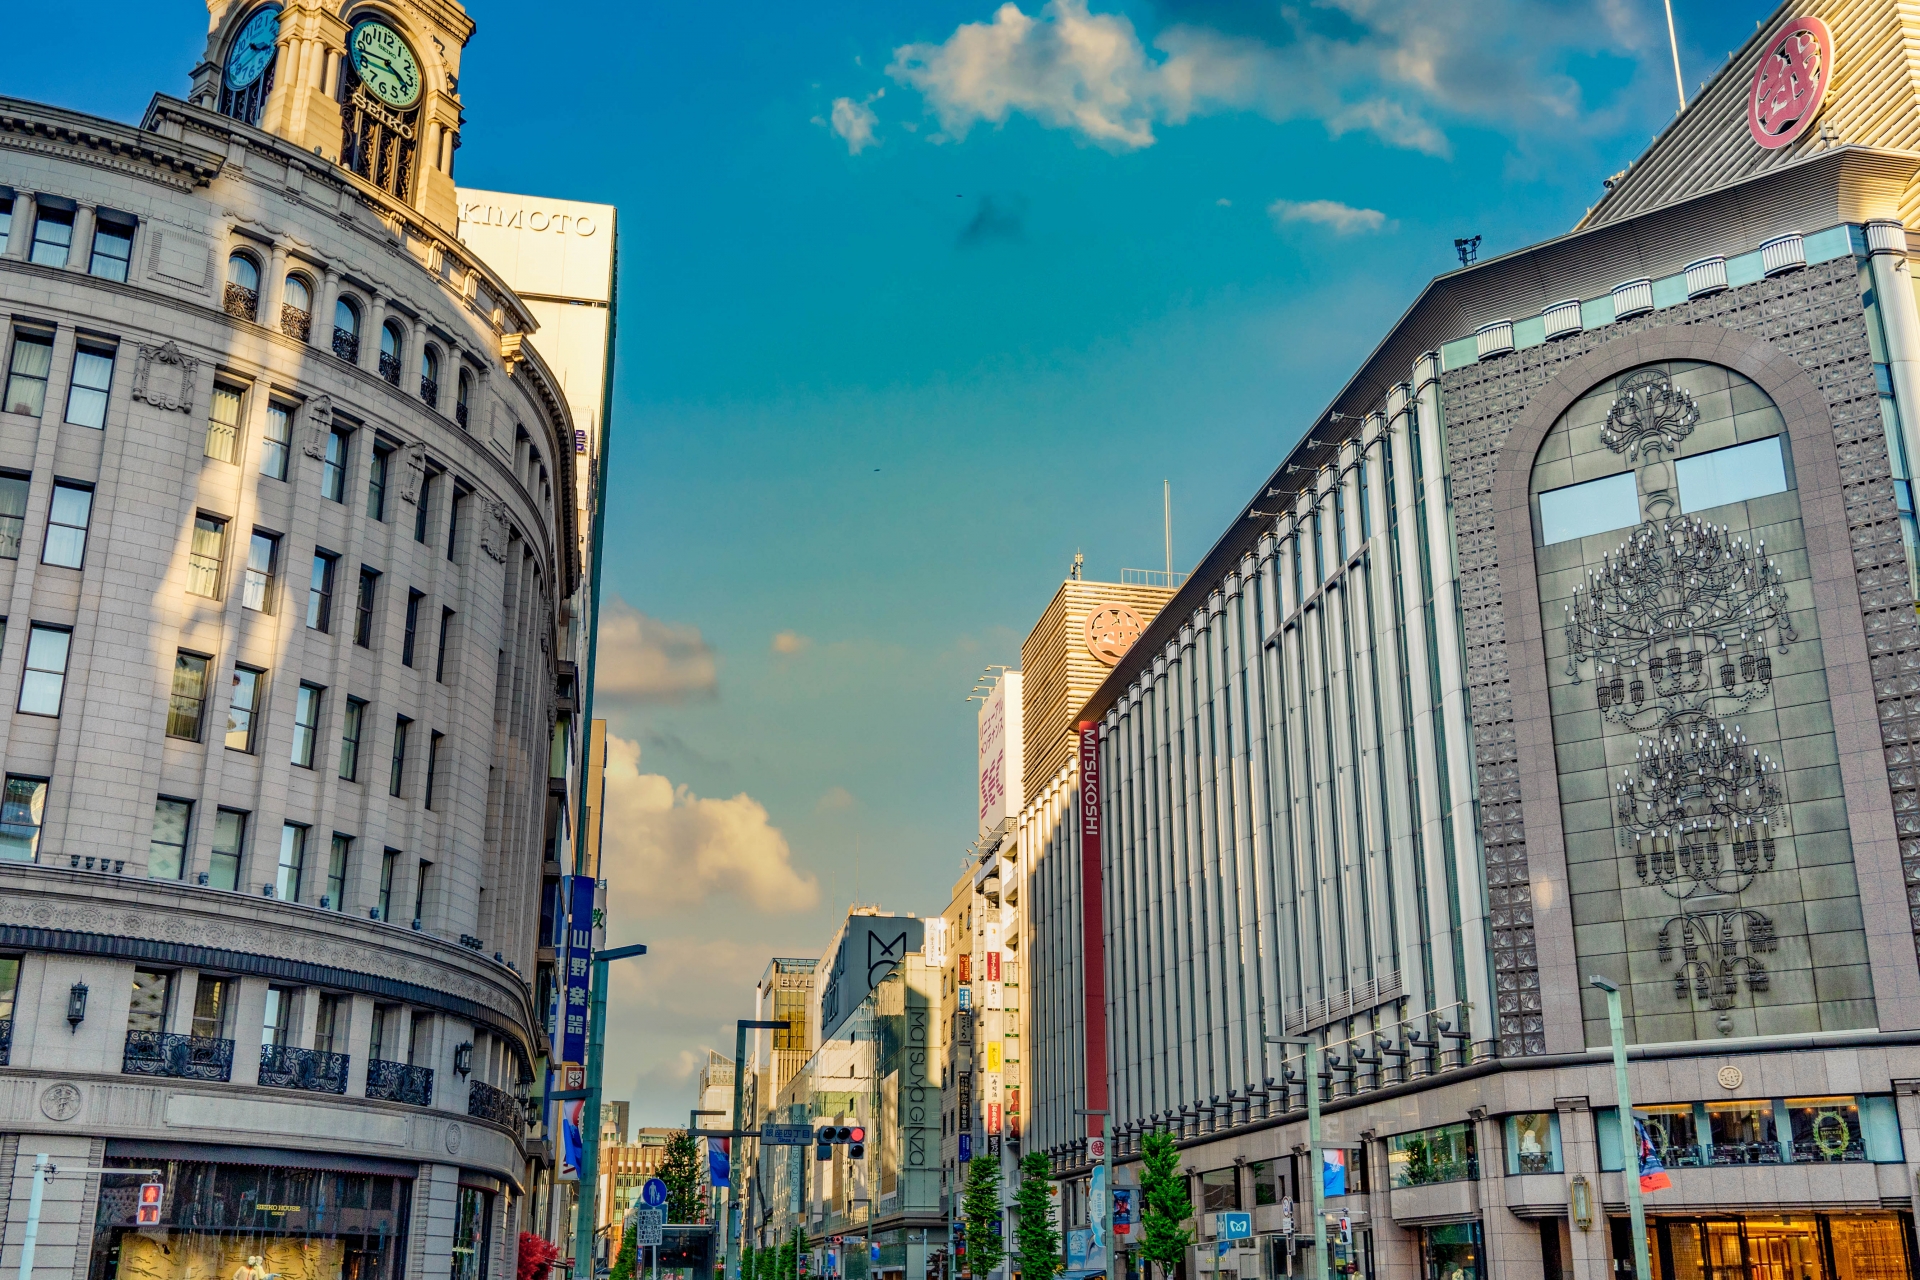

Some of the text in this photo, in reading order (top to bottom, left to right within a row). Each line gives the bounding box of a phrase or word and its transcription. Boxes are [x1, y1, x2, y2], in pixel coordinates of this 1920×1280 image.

[362, 30, 372, 46] 10
[373, 28, 381, 42] 11
[383, 32, 394, 49] 12
[378, 44, 397, 60] SEIKO
[398, 45, 402, 58] 1
[360, 55, 369, 69] 8
[404, 59, 411, 74] 2
[369, 69, 378, 83] 7
[406, 73, 414, 88] 3
[378, 81, 387, 94] 6
[390, 85, 399, 99] 5
[399, 84, 409, 97] 4
[352, 92, 413, 139] SEIKO
[459, 202, 597, 237] KIMOTO
[1083, 729, 1098, 835] MITSUKOSHI
[567, 929, 590, 1036] 山野楽器
[765, 1129, 810, 1139] 銀座四丁目
[256, 1203, 301, 1212] SEIKO HOUSE
